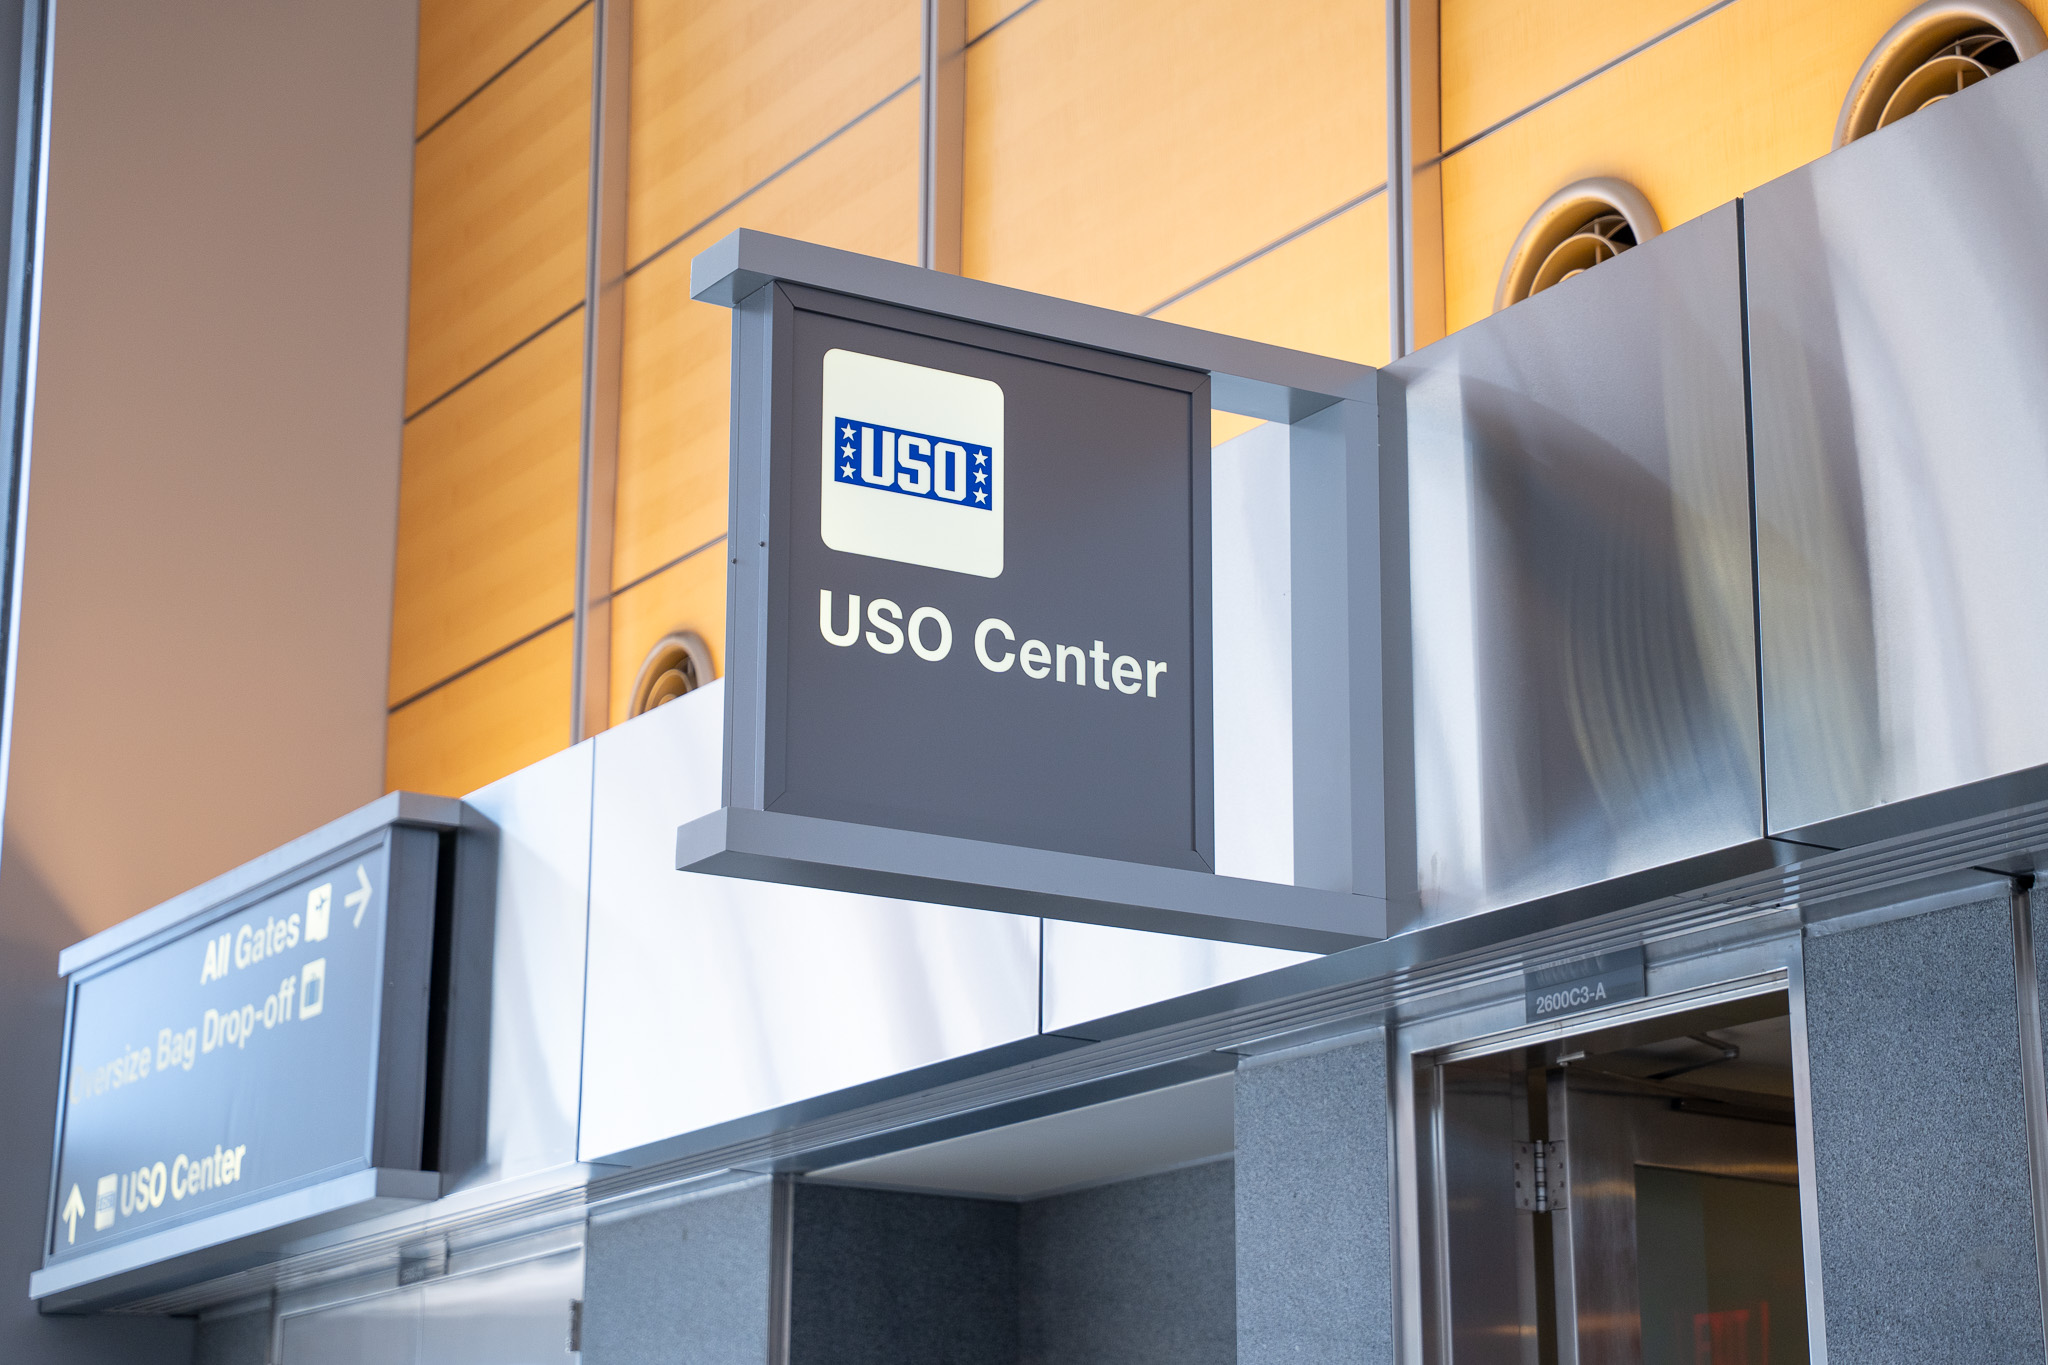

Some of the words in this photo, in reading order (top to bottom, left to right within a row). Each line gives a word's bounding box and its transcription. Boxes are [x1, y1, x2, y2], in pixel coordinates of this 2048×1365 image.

[860, 426, 967, 502] USO
[819, 589, 953, 662] USO
[974, 617, 1168, 699] Center
[201, 933, 231, 985] All
[234, 913, 301, 970] Gates
[1536, 982, 1606, 1014] 2600C3-A
[69, 1044, 151, 1104] Oversize
[156, 1027, 198, 1071] Bag
[202, 975, 296, 1053] Drop-off
[120, 1161, 167, 1217] USO
[171, 1143, 247, 1201] Center
